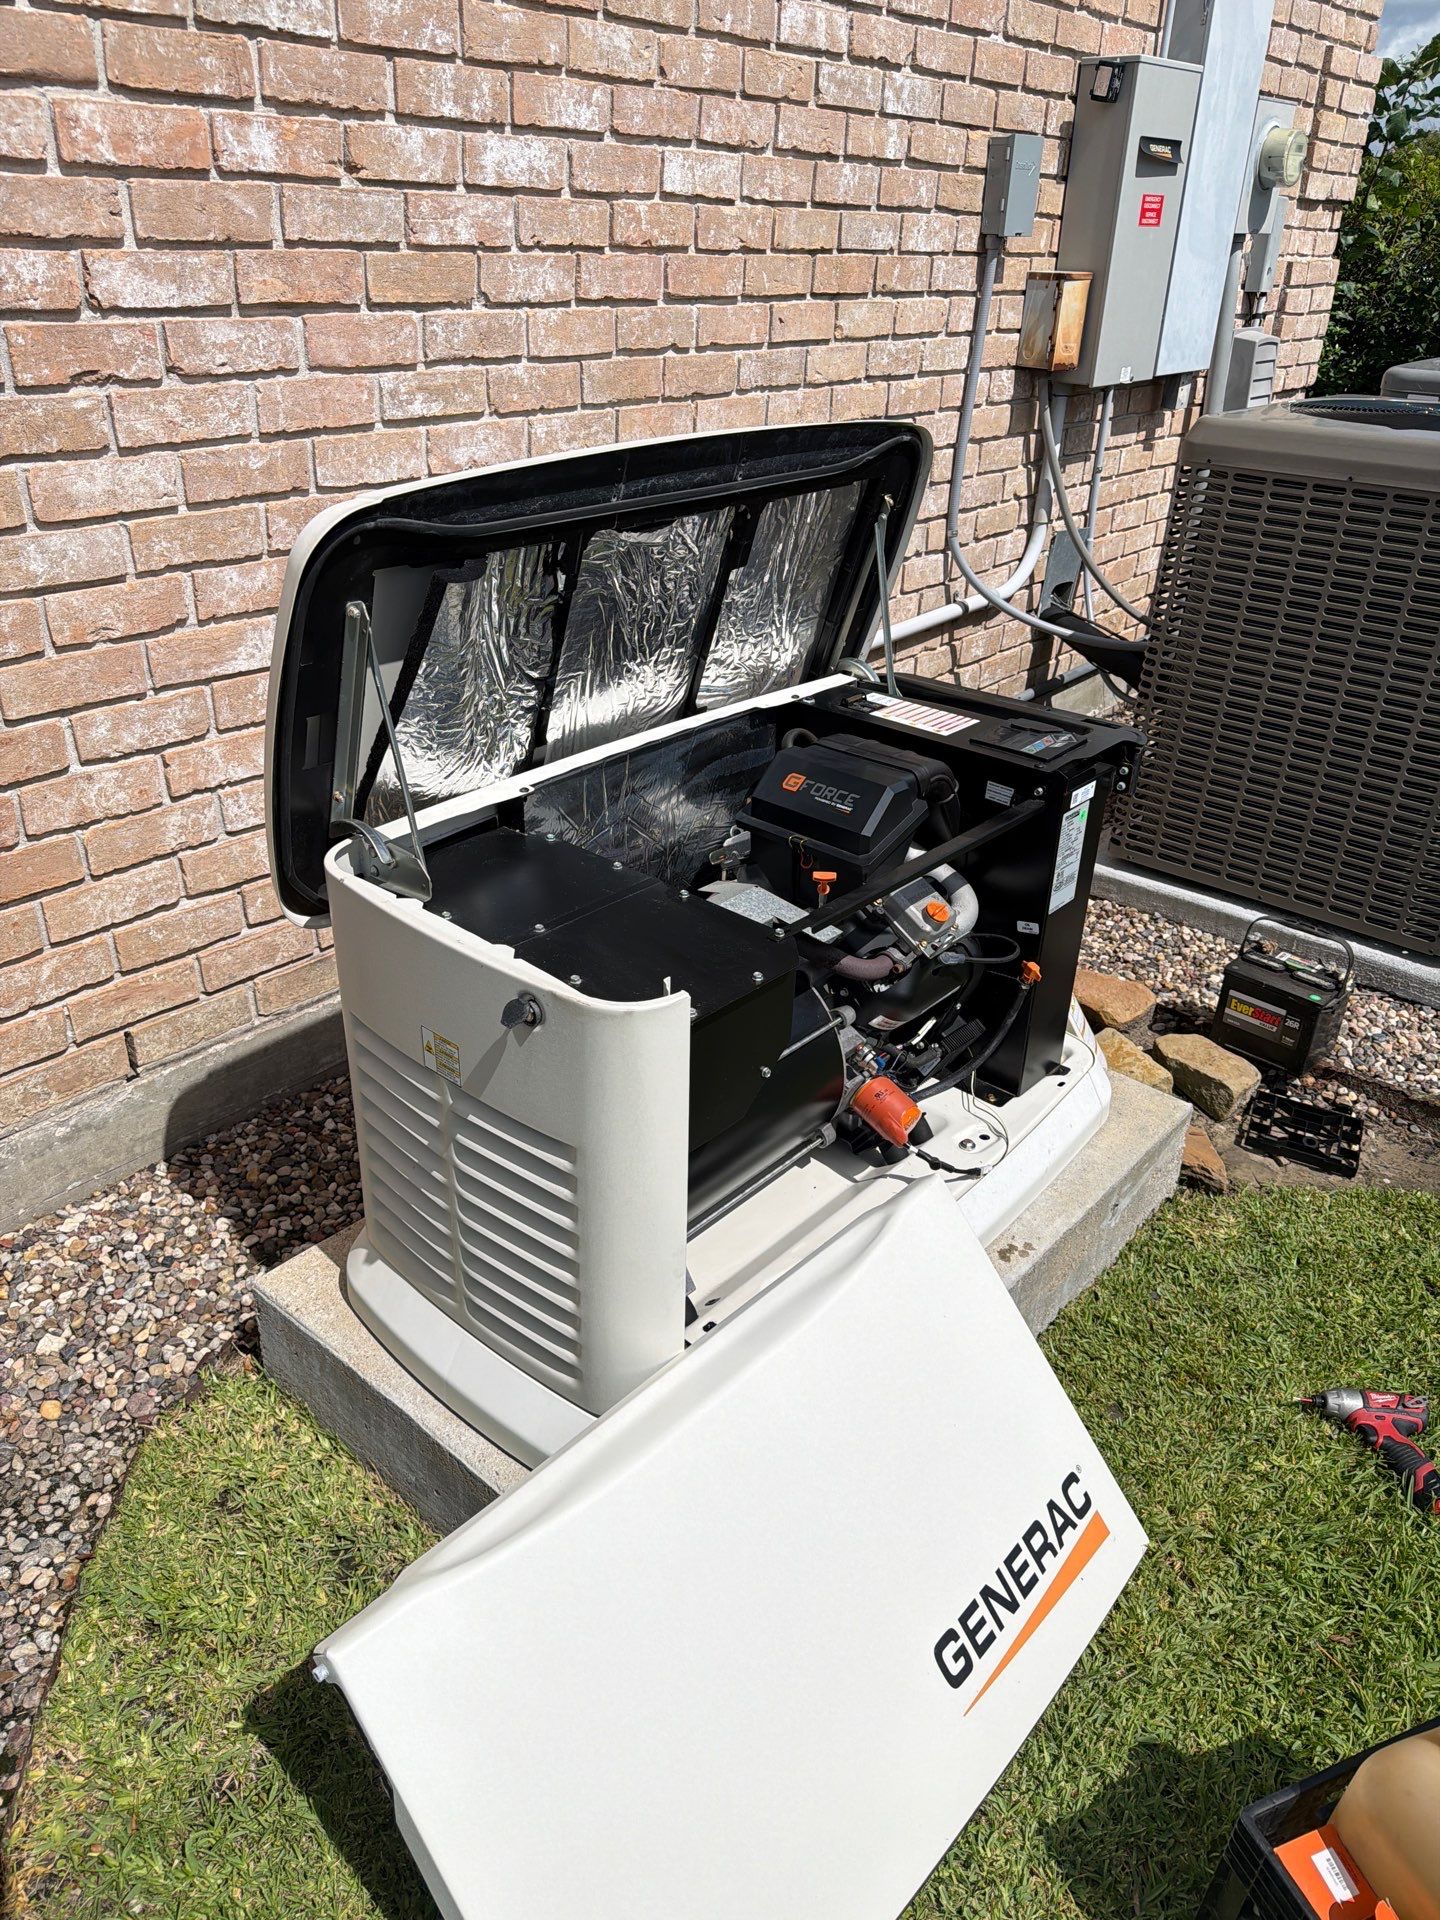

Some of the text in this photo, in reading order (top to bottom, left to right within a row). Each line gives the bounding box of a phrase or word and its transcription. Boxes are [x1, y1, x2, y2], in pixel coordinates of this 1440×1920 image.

[1149, 144, 1172, 154] GENERAC
[1230, 998, 1281, 1026] EverStart
[1284, 1018, 1300, 1030] 26R
[933, 1471, 1092, 1690] GENERAC
